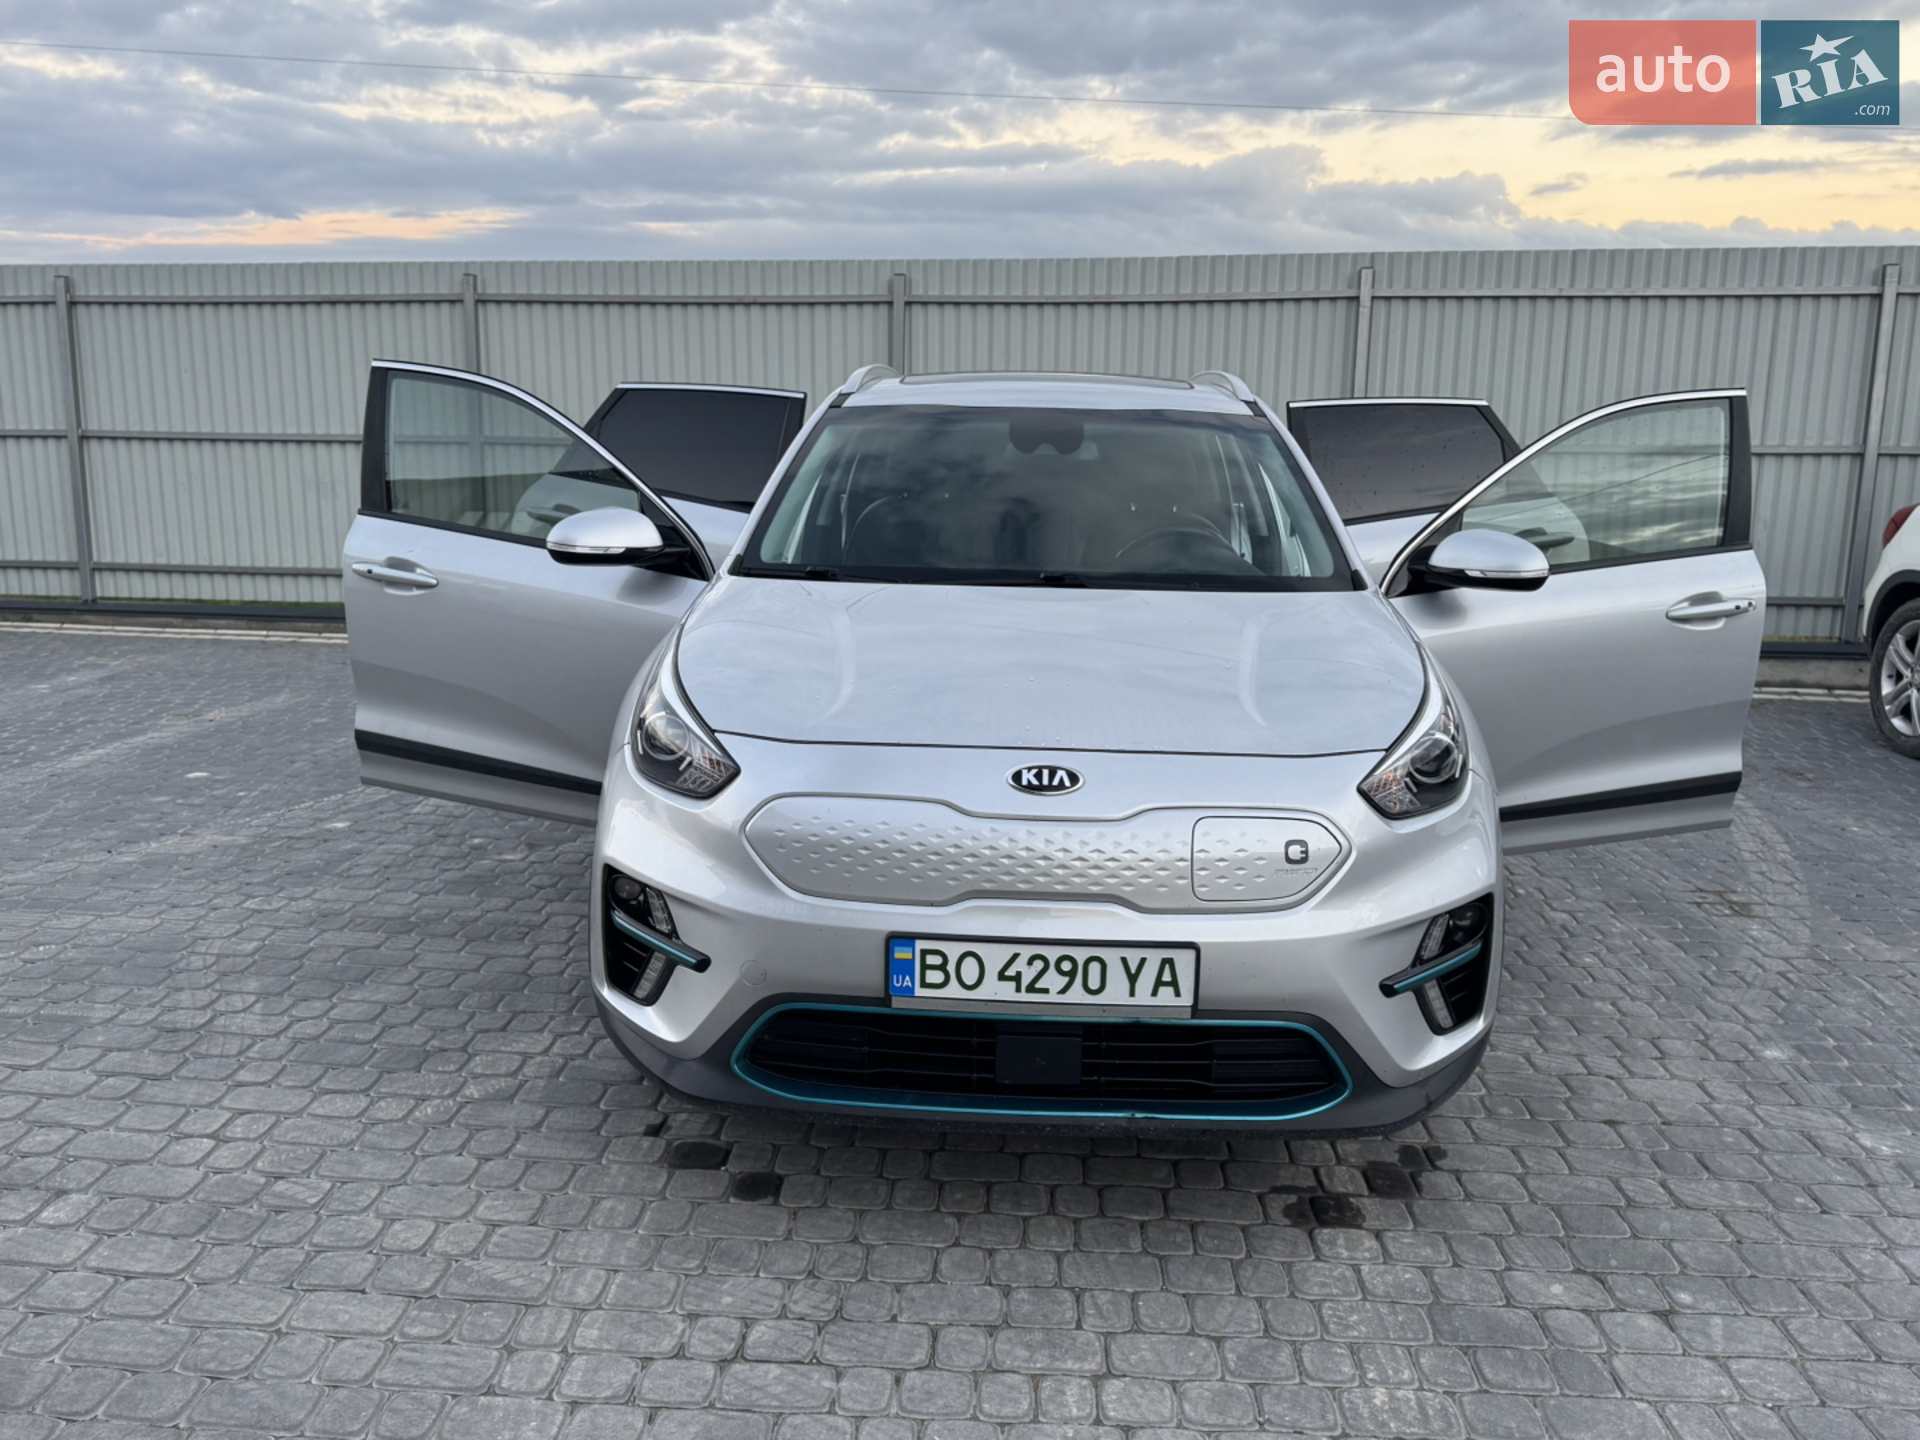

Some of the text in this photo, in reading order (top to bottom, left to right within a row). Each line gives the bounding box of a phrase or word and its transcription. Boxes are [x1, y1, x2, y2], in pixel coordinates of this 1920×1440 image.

[1021, 768, 1072, 787] KIA
[893, 974, 913, 988] UA
[919, 948, 1182, 998] BO 4290 YA
